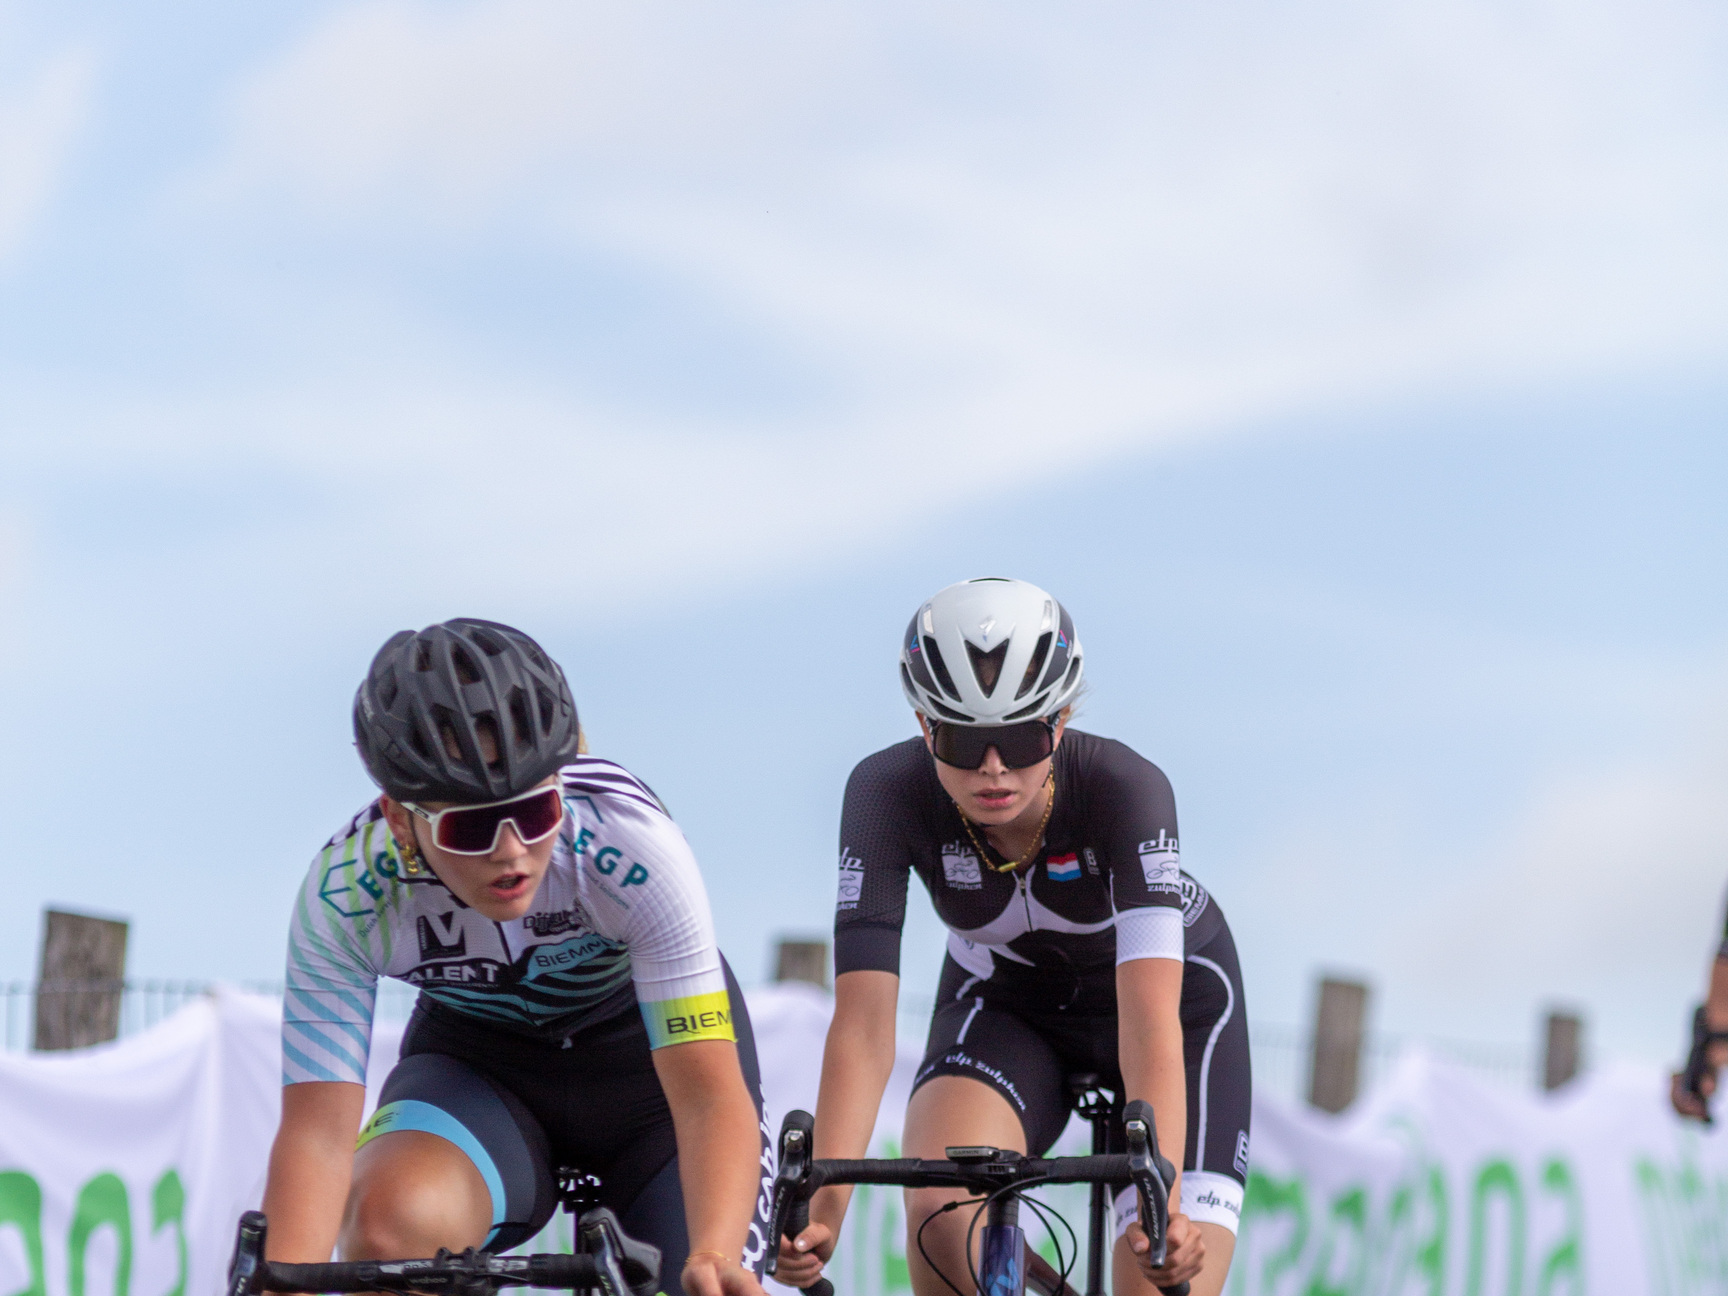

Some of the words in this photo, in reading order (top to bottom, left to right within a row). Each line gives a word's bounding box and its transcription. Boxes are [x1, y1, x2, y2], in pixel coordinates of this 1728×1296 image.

[1138, 829, 1179, 853] elp
[356, 839, 401, 900] EG
[839, 846, 865, 871] lp
[403, 963, 498, 983] ALENT
